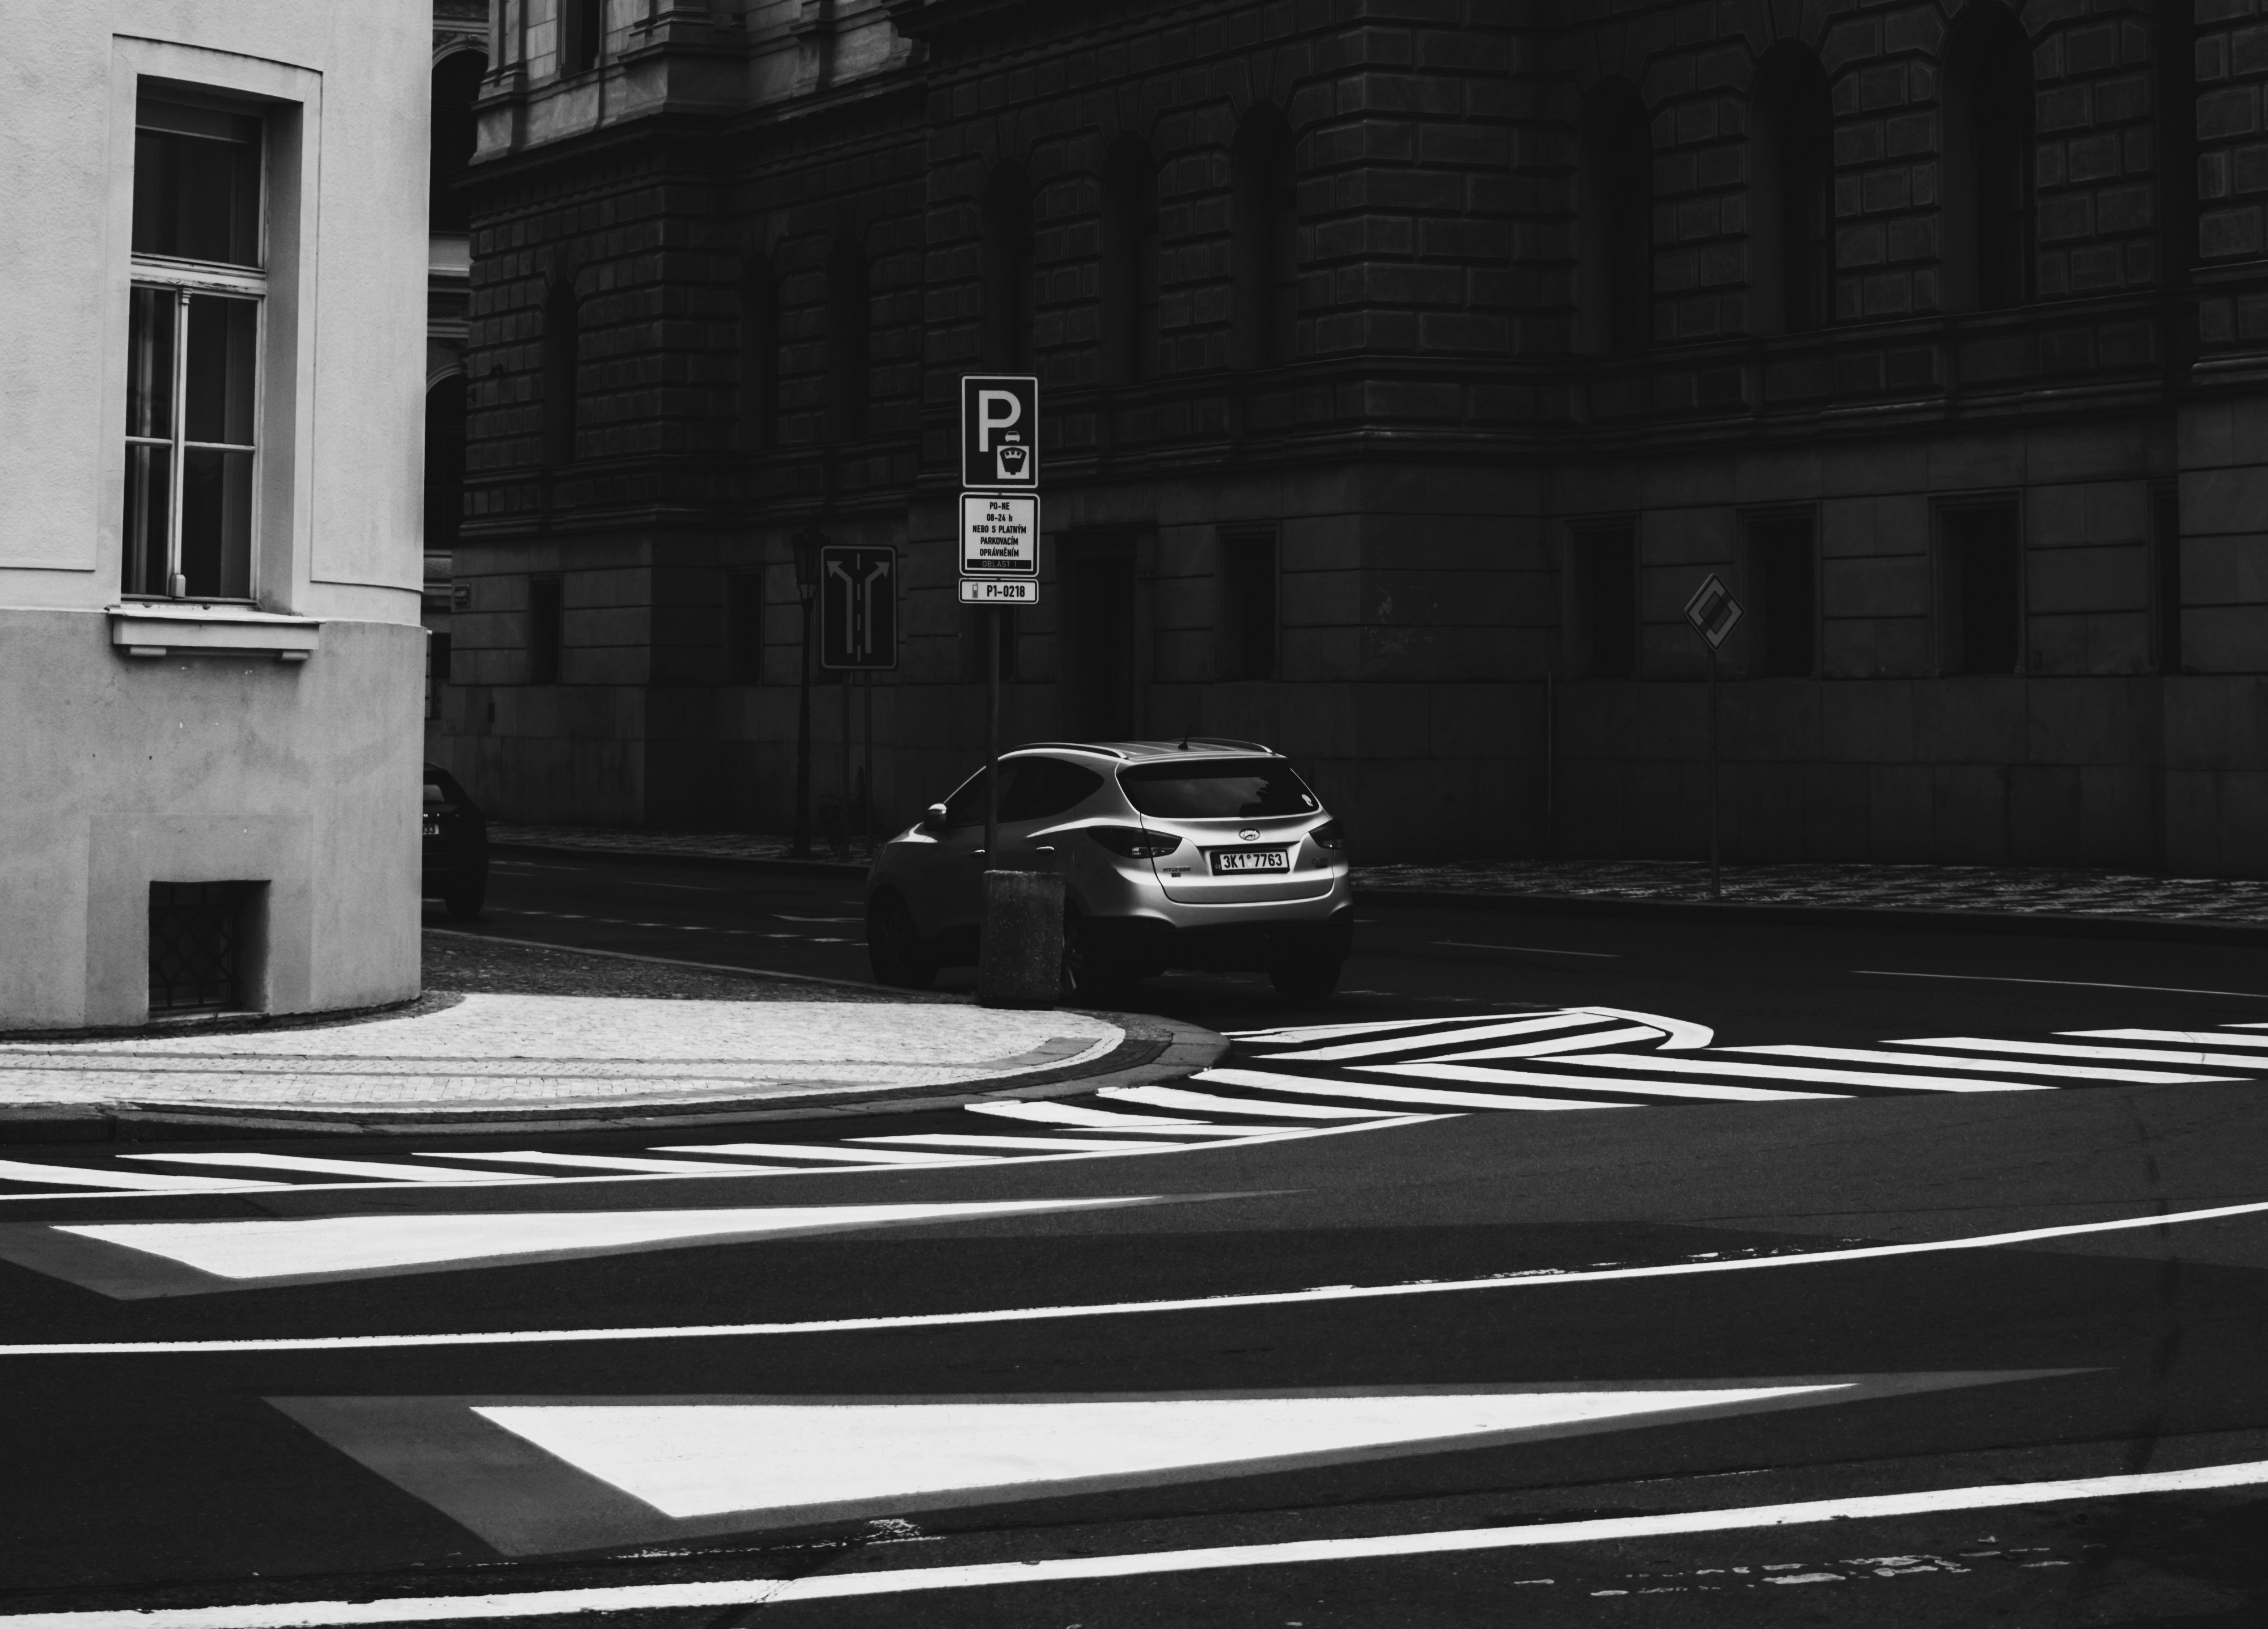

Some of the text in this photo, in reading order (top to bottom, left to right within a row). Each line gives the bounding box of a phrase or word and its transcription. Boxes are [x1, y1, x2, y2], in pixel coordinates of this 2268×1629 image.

[979, 390, 1021, 452] P
[989, 502, 1010, 510] PO-NE
[972, 524, 989, 533] NEBO
[998, 524, 1026, 534] PLATNÝM
[980, 536, 1018, 545] PARKOVACÍM
[980, 547, 1019, 557] OPRÁVNĚNÍM
[987, 585, 1025, 597] P1-0218
[1223, 853, 1283, 869] 3K1 7763
